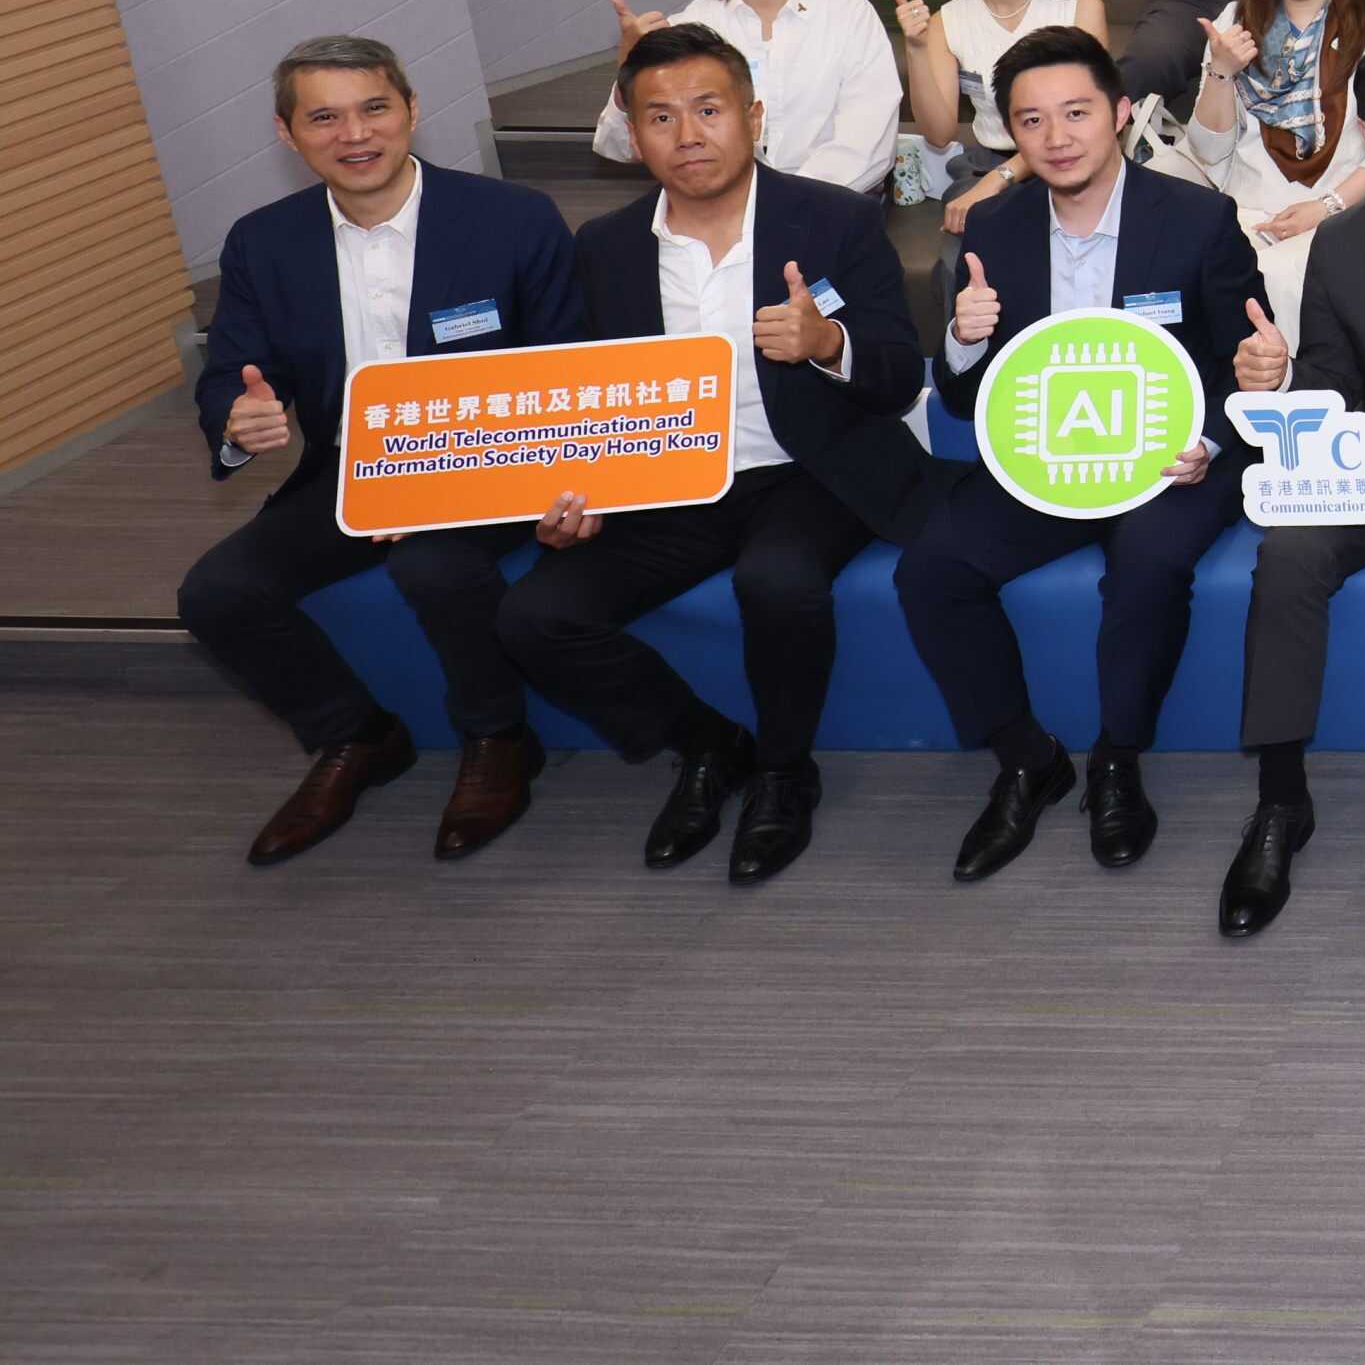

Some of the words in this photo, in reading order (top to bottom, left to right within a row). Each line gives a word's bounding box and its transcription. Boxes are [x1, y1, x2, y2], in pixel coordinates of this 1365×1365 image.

[364, 375, 719, 429] 香港世界電訊及資訊社會日
[1057, 388, 1124, 439] AI
[385, 433, 447, 453] World
[453, 419, 651, 447] Telecommunication
[655, 410, 693, 429] and
[355, 454, 478, 478] Information
[484, 445, 558, 466] Society
[563, 443, 601, 461] Day
[607, 439, 661, 456] Hong
[668, 434, 718, 450] Kong
